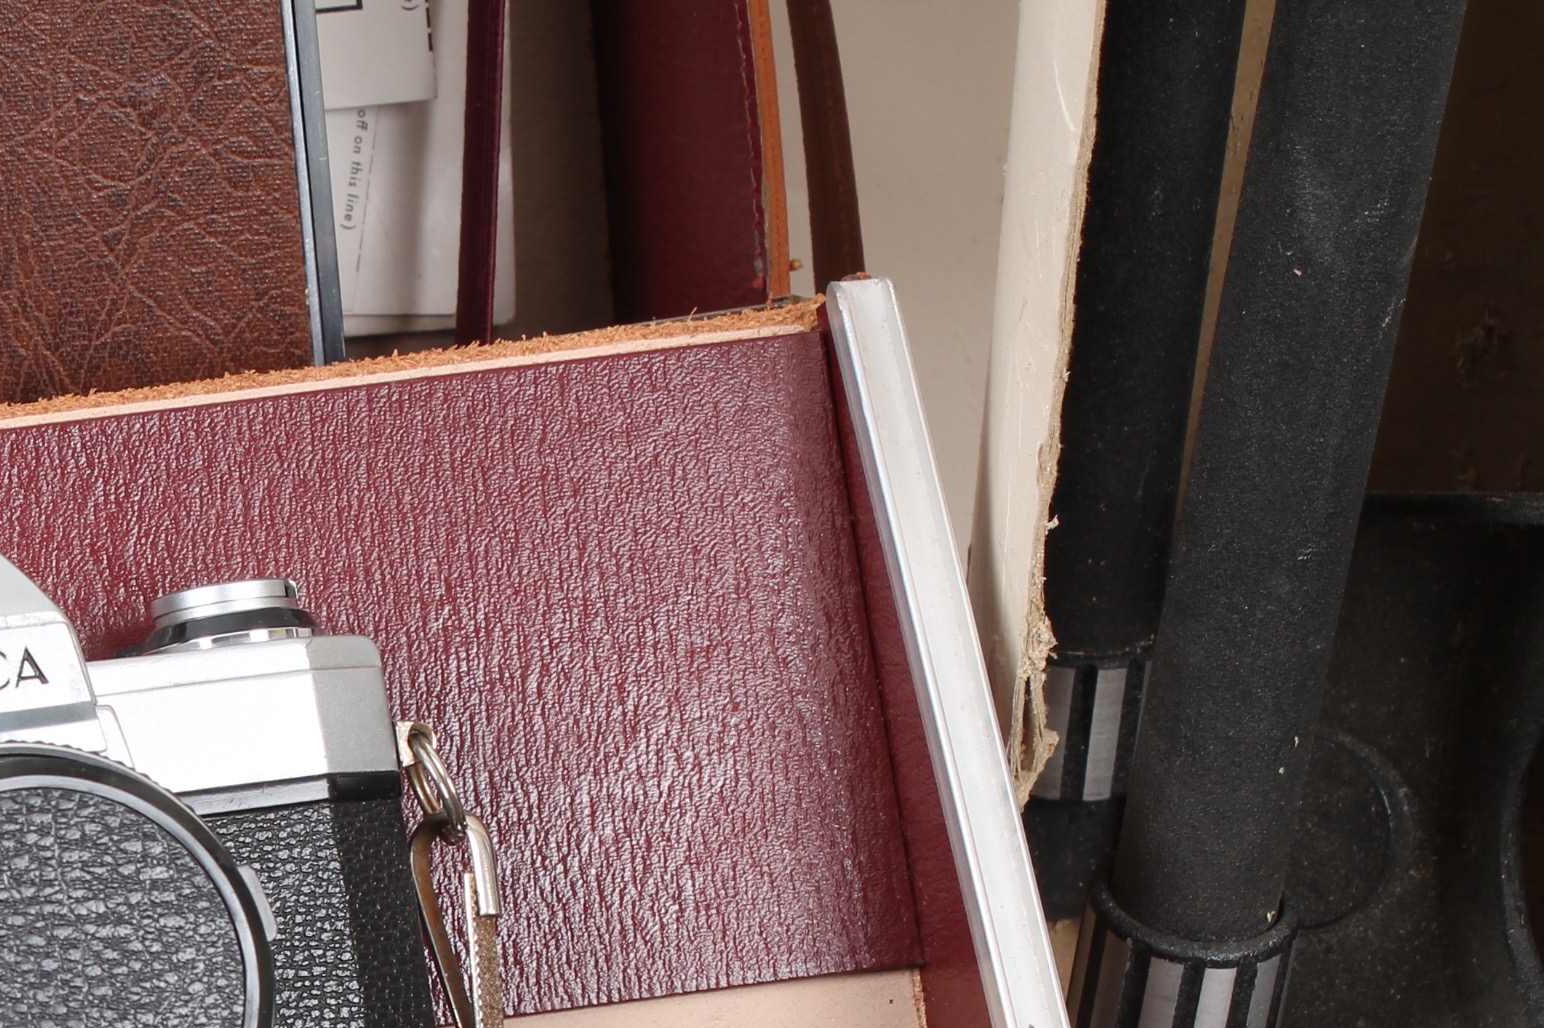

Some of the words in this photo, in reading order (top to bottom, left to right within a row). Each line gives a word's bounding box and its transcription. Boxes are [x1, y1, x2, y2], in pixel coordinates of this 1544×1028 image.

[356, 108, 369, 131] off
[353, 136, 363, 154] on
[348, 161, 364, 188] this
[340, 193, 360, 230] line)
